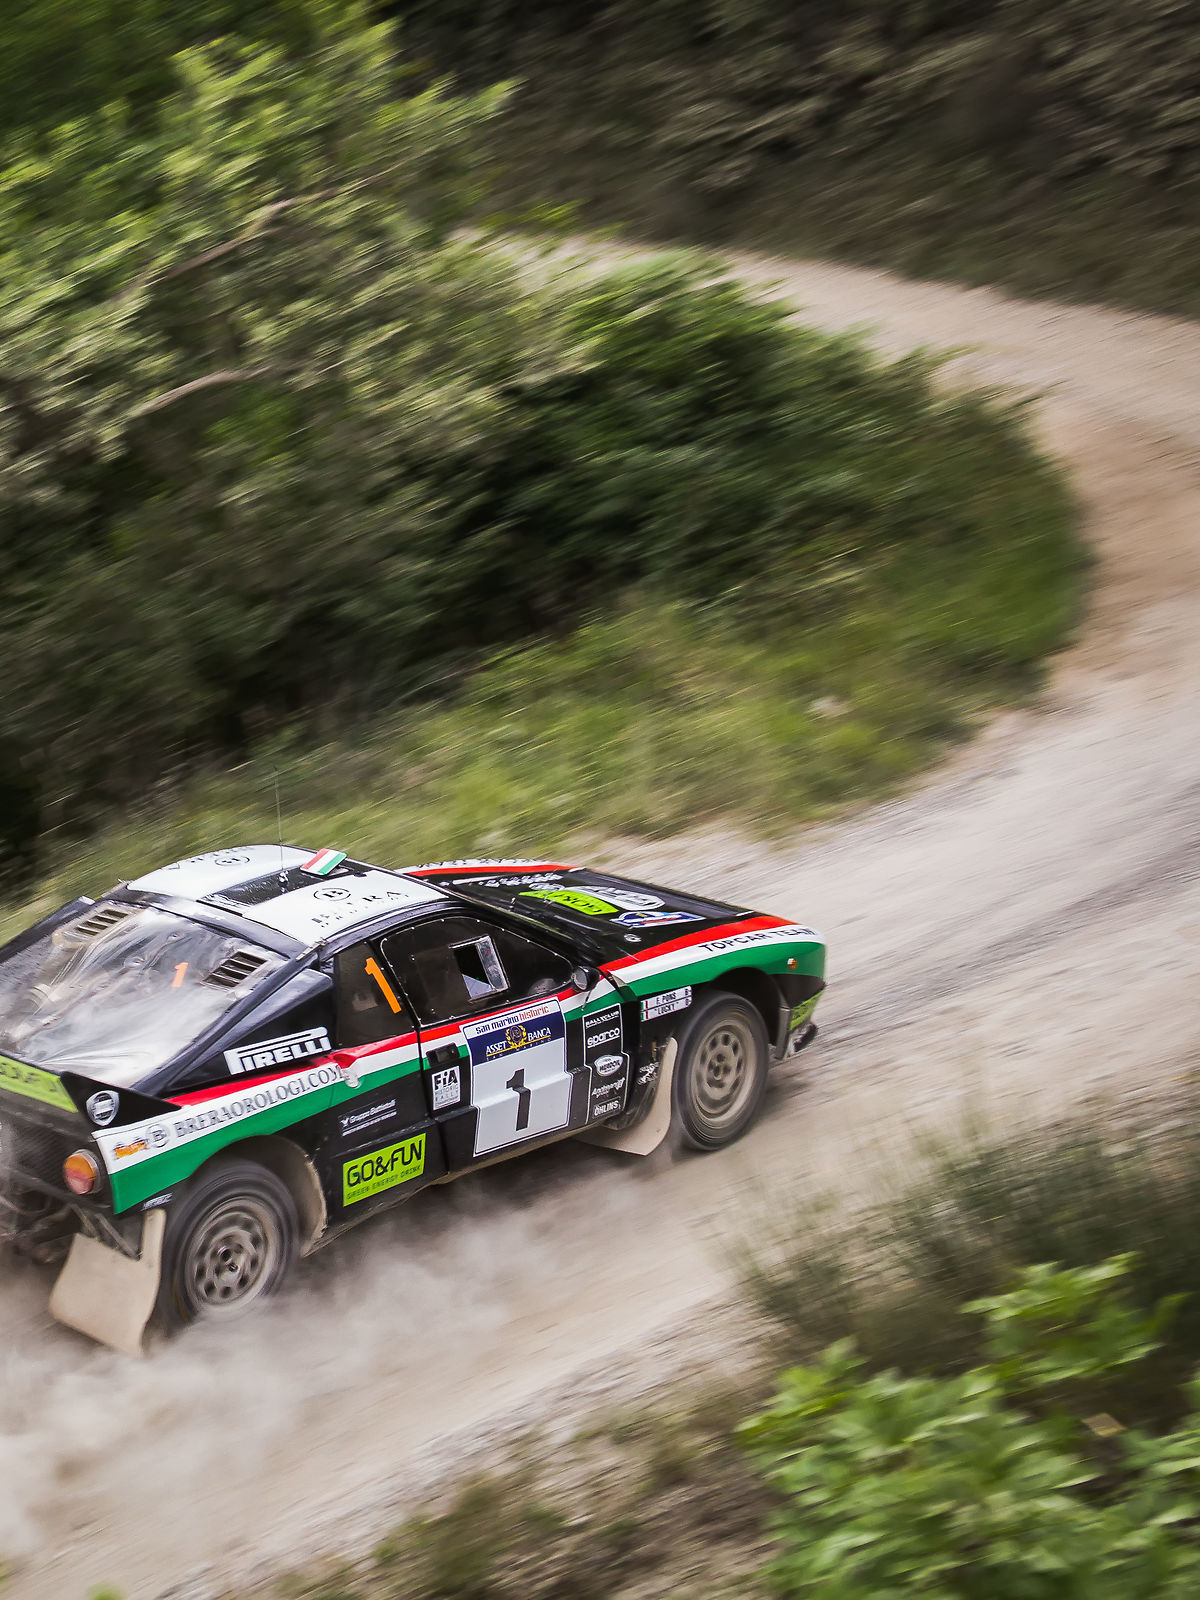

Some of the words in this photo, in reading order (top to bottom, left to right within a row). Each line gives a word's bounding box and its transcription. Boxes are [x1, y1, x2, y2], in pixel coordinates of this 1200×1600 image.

[698, 932, 772, 952] TOPCAR
[773, 927, 817, 938] TEAM
[171, 961, 189, 988] 1
[364, 956, 402, 1014] 1
[475, 1023, 491, 1035] san
[491, 1015, 519, 1029] marino
[519, 1005, 550, 1022] historic
[223, 1026, 332, 1076] PIRELLI
[485, 1040, 507, 1055] ASSET
[527, 1027, 552, 1042] BANCA
[587, 1027, 621, 1047] sparco
[505, 1068, 532, 1132] 1
[347, 1140, 422, 1187] GO&FUN
